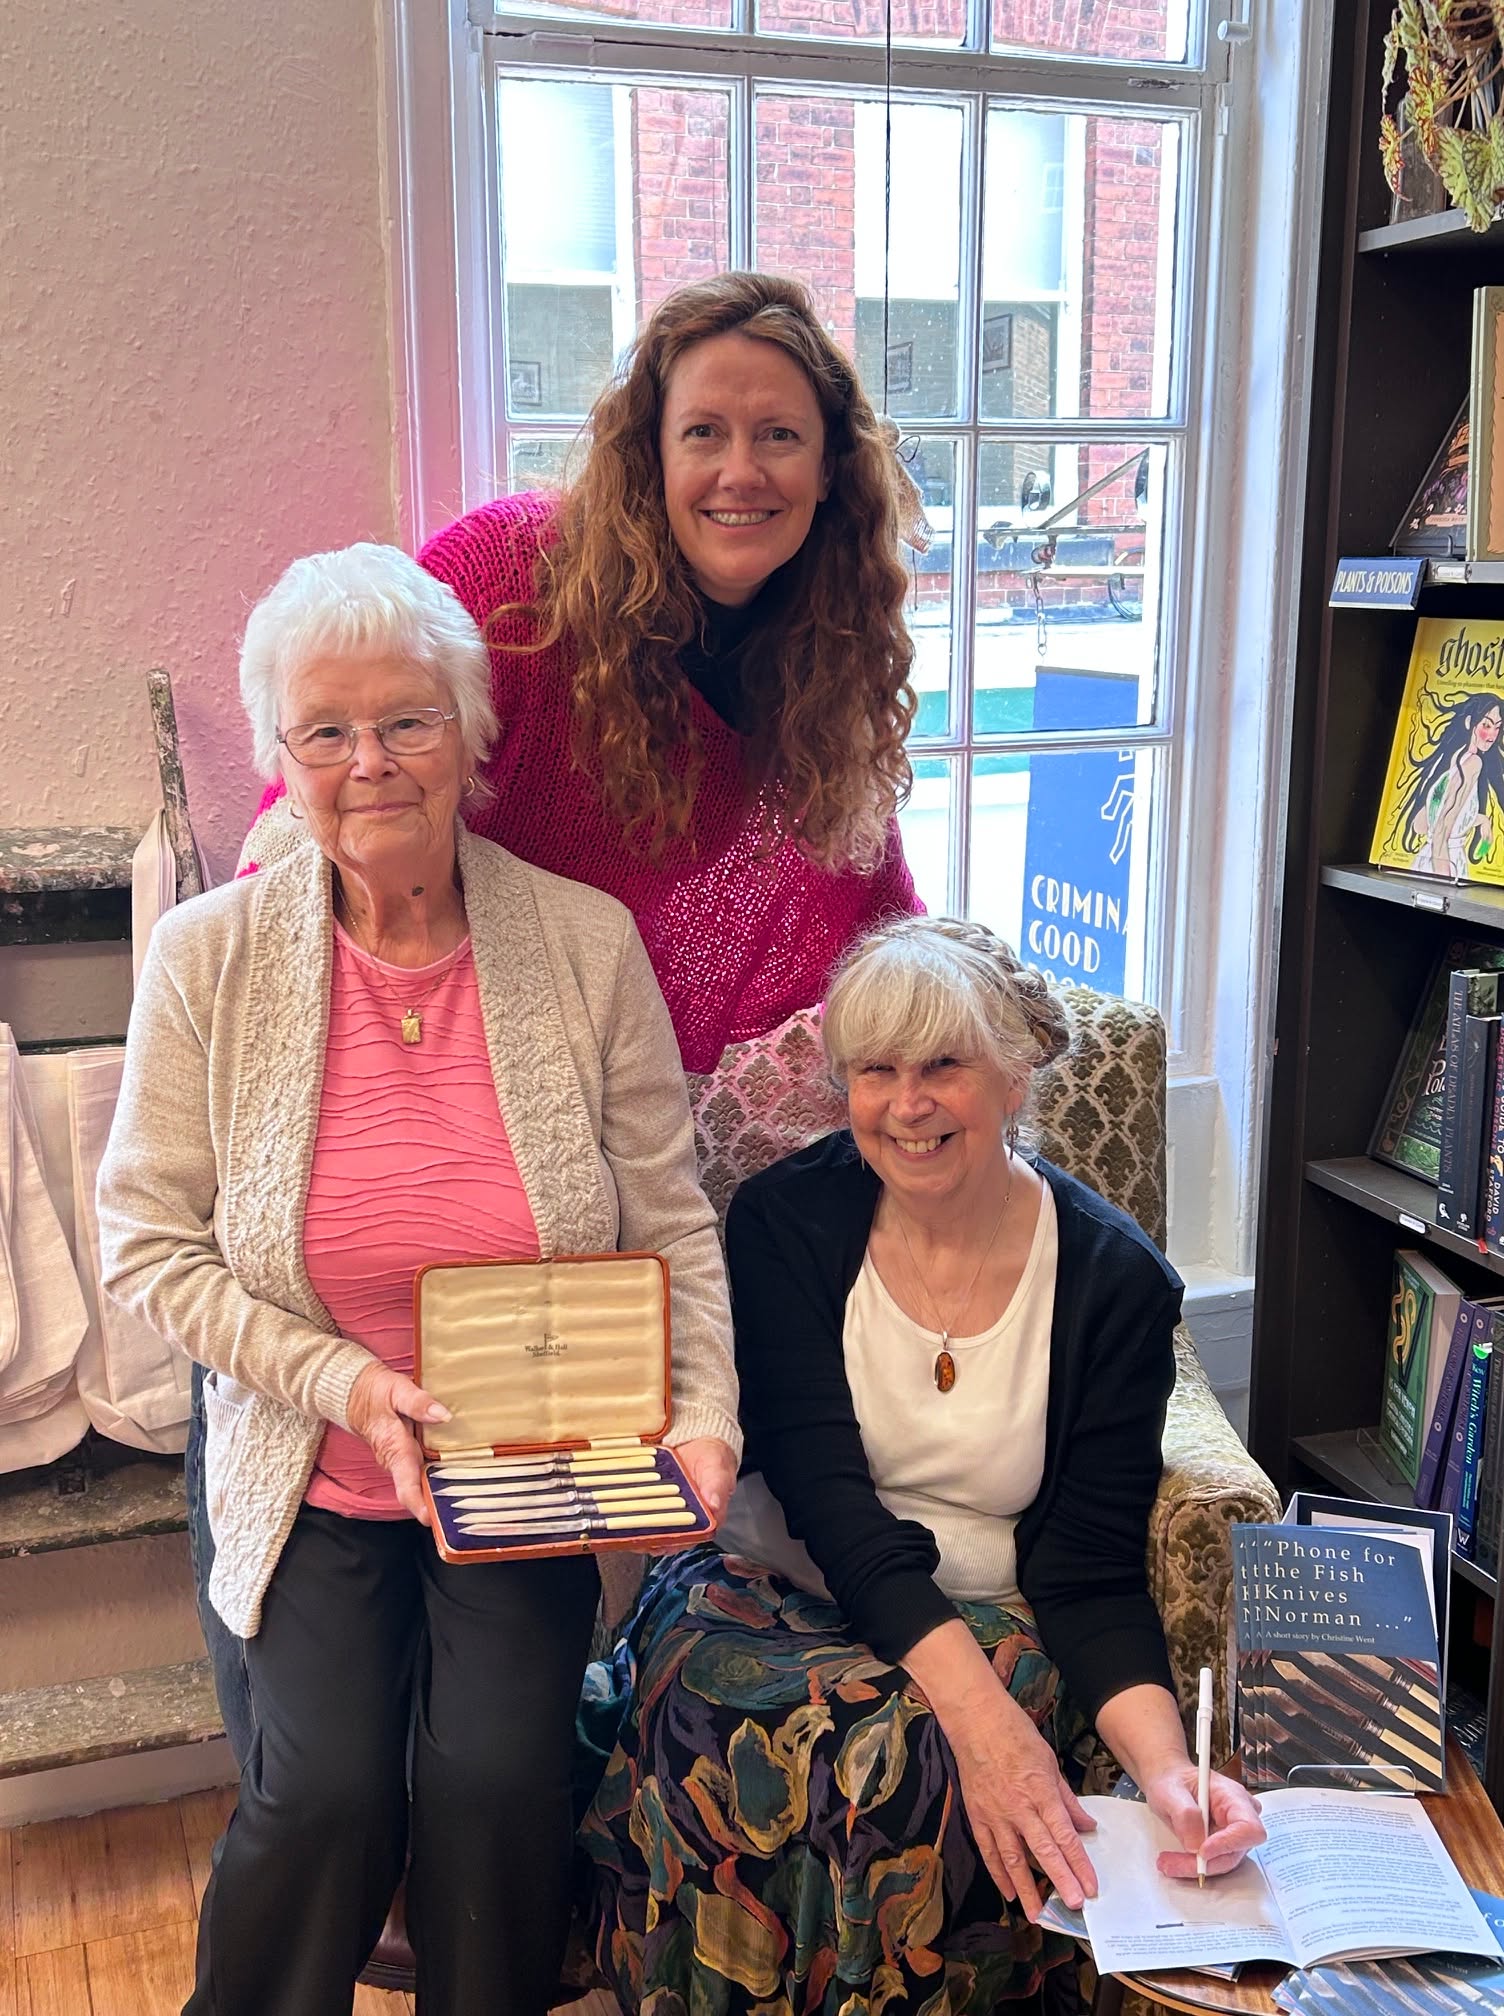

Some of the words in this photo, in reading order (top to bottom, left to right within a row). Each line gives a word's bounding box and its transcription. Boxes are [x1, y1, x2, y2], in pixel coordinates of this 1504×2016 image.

[1334, 571, 1367, 593] PLANTS
[1366, 571, 1376, 593] &
[1375, 571, 1414, 595] POISONS
[1028, 919, 1101, 974] GOOD
[1450, 1012, 1462, 1053] ATLAS
[1445, 1075, 1457, 1125] DEADLY
[1491, 1096, 1500, 1150] POISONS
[1442, 1126, 1455, 1174] PLANTS
[1486, 1168, 1495, 1222] STAFFORD
[1492, 1181, 1501, 1215] DAVID
[1470, 1379, 1482, 1419] Witch's
[1465, 1422, 1477, 1464] Garden
[1264, 1562, 1300, 1579] the
[1314, 1564, 1365, 1583] Fish
[1364, 1547, 1396, 1567] for
[1264, 1584, 1348, 1603] Knives
[1265, 1606, 1362, 1626] Norman
[1273, 1631, 1291, 1639] short
[1292, 1633, 1309, 1641] story
[1311, 1633, 1320, 1642] by
[1321, 1633, 1354, 1643] Christine
[1355, 1634, 1375, 1644] Went
